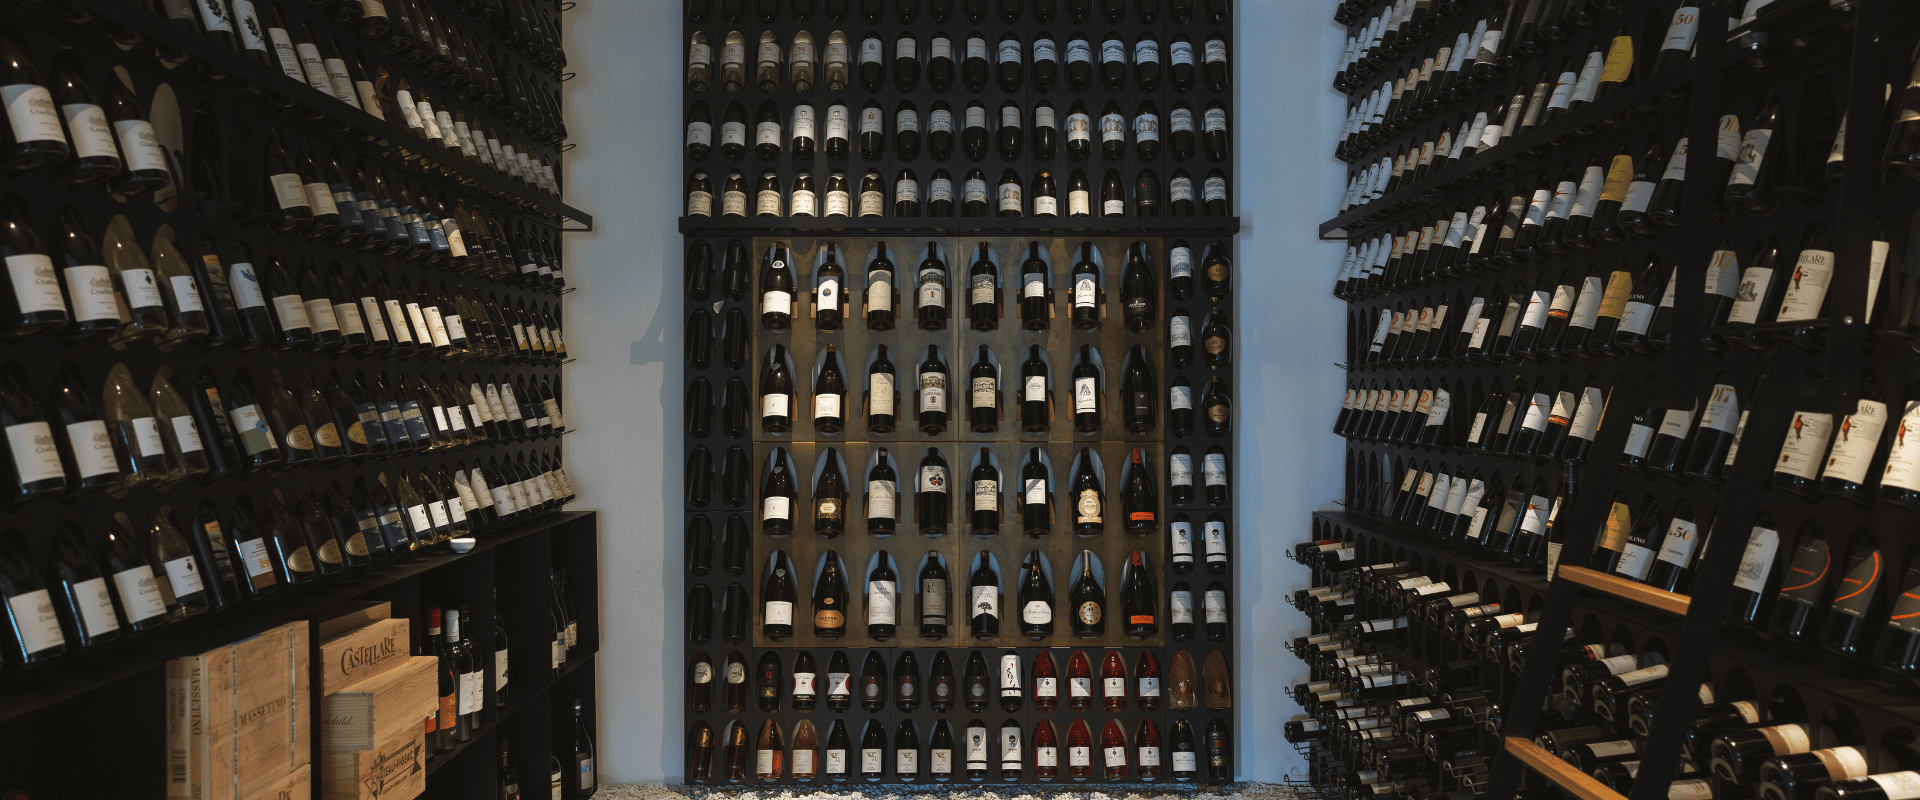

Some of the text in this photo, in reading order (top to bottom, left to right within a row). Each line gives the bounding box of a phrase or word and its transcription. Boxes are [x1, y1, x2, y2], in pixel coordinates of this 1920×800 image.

[341, 636, 396, 676] CASTELLARE
[190, 667, 202, 736] MASSETINO
[240, 696, 287, 726] MASSETINO
